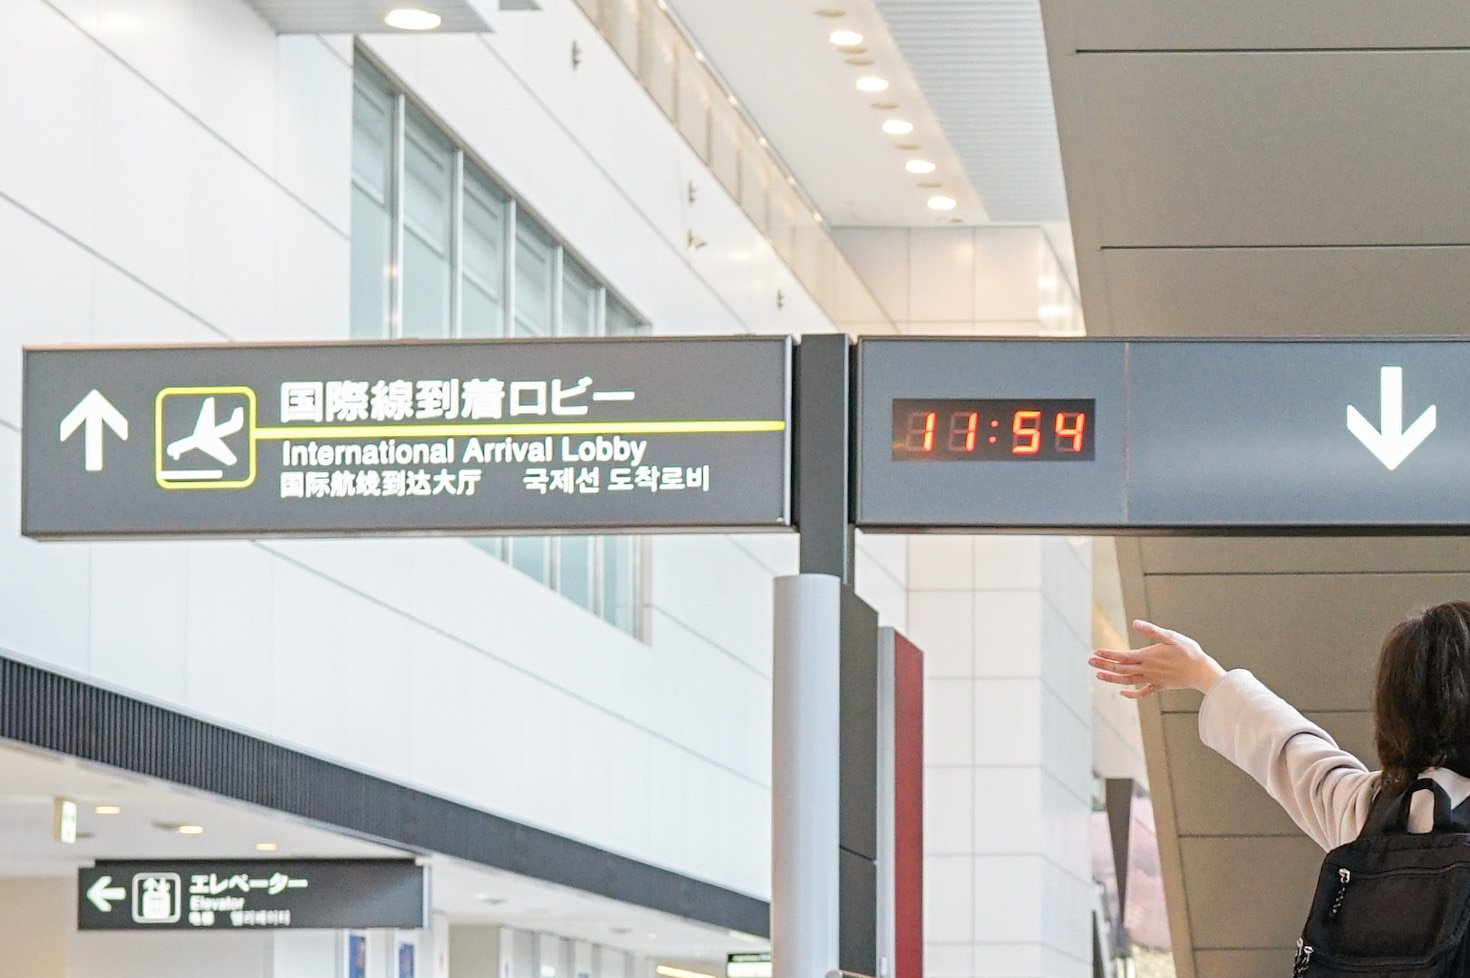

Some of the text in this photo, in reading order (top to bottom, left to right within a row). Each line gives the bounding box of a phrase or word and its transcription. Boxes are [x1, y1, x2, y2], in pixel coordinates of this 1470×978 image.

[280, 376, 635, 422] 国際線到着ロビー
[921, 411, 1085, 454] 11:54
[282, 435, 648, 467] International Arrival Lobby
[280, 469, 482, 498] 国际航线到达大厅
[523, 464, 710, 494] 국제선 도착로비
[189, 872, 308, 895] エレベーター
